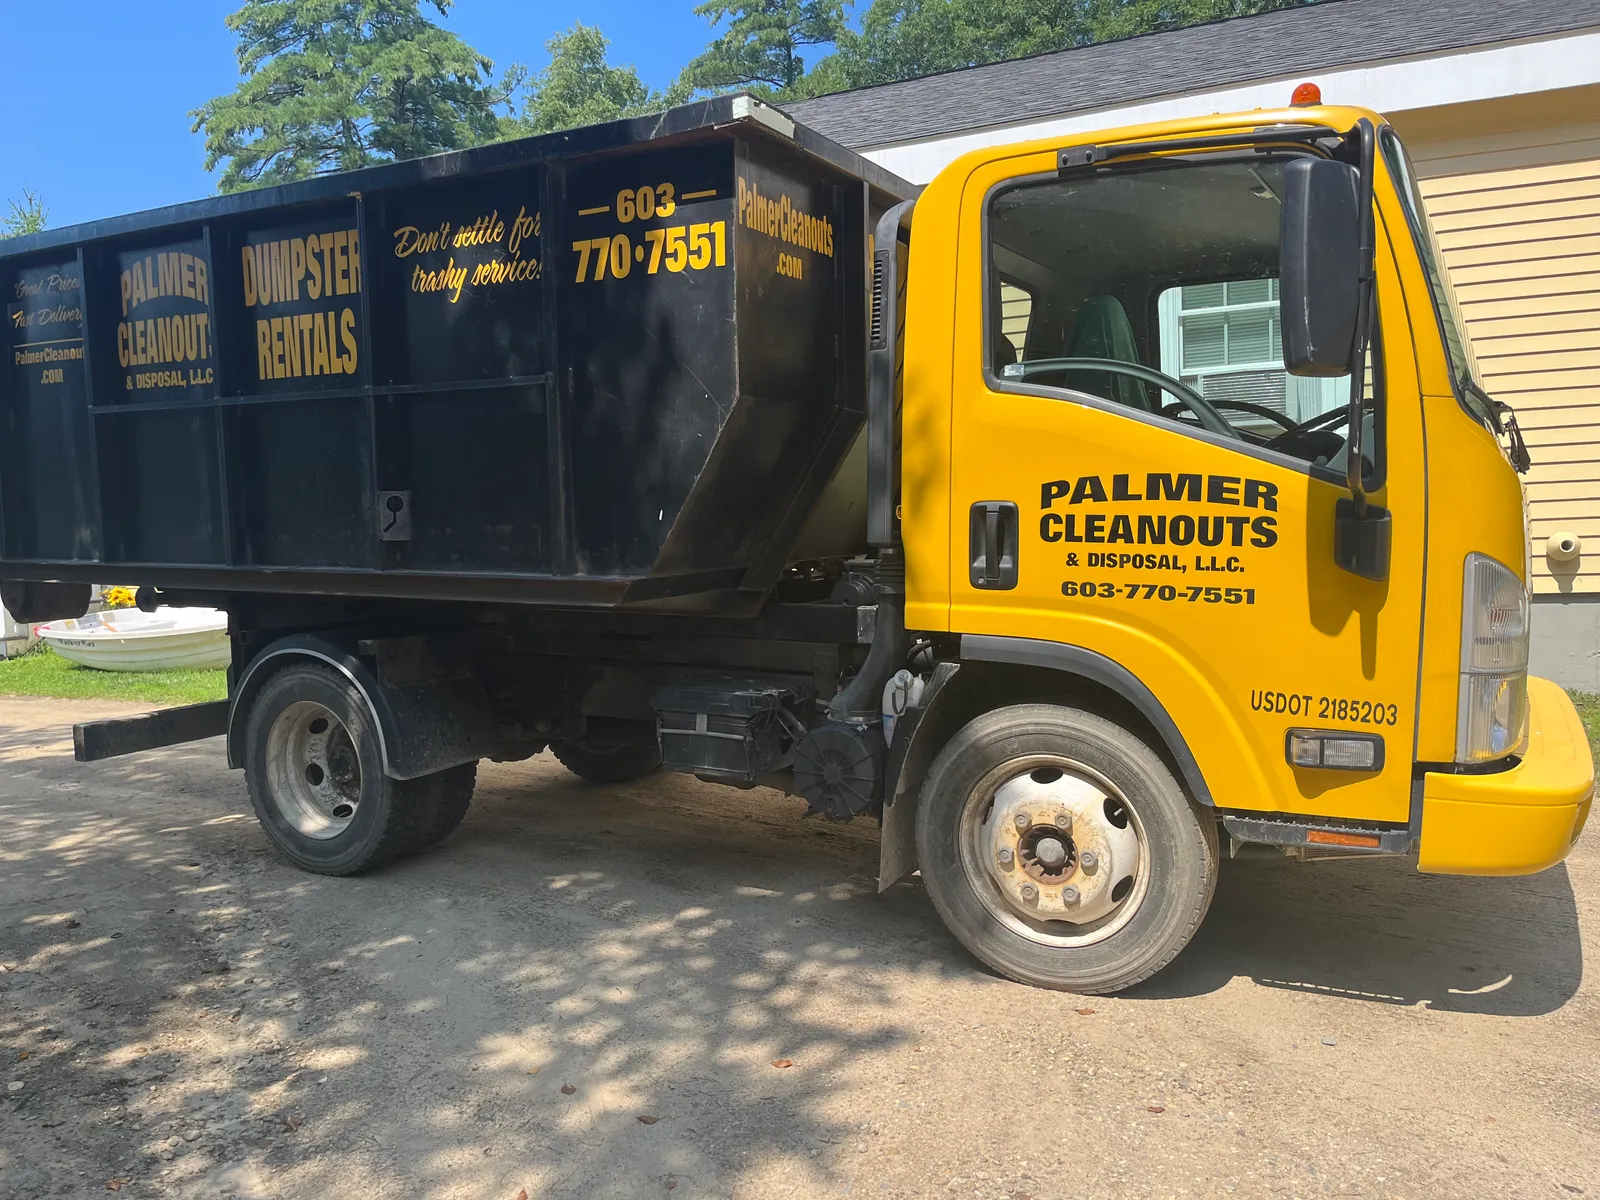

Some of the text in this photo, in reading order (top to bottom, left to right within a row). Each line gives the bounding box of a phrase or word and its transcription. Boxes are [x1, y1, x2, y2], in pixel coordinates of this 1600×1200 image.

[616, 182, 676, 223] 603
[738, 176, 834, 258] PalmerCleanouts
[393, 222, 450, 258] Don't
[453, 209, 505, 248] settle
[120, 252, 209, 317] PALMER
[241, 229, 361, 307] DUMPSTER
[412, 257, 468, 303] trashy
[14, 279, 43, 299] Great
[12, 310, 34, 329] Fast
[117, 312, 212, 368] CLEANOUT
[256, 307, 358, 380] RENTALS
[126, 376, 134, 390] &
[136, 370, 187, 389] DISPOSAL,
[1041, 473, 1279, 512] PALMER
[1039, 513, 1279, 548] CLEANOUTS
[1065, 552, 1245, 573] & DISPOSAL, L.L.C.
[1061, 581, 1256, 605] 603-770-7551
[1251, 689, 1398, 726] USDOT 2185203
